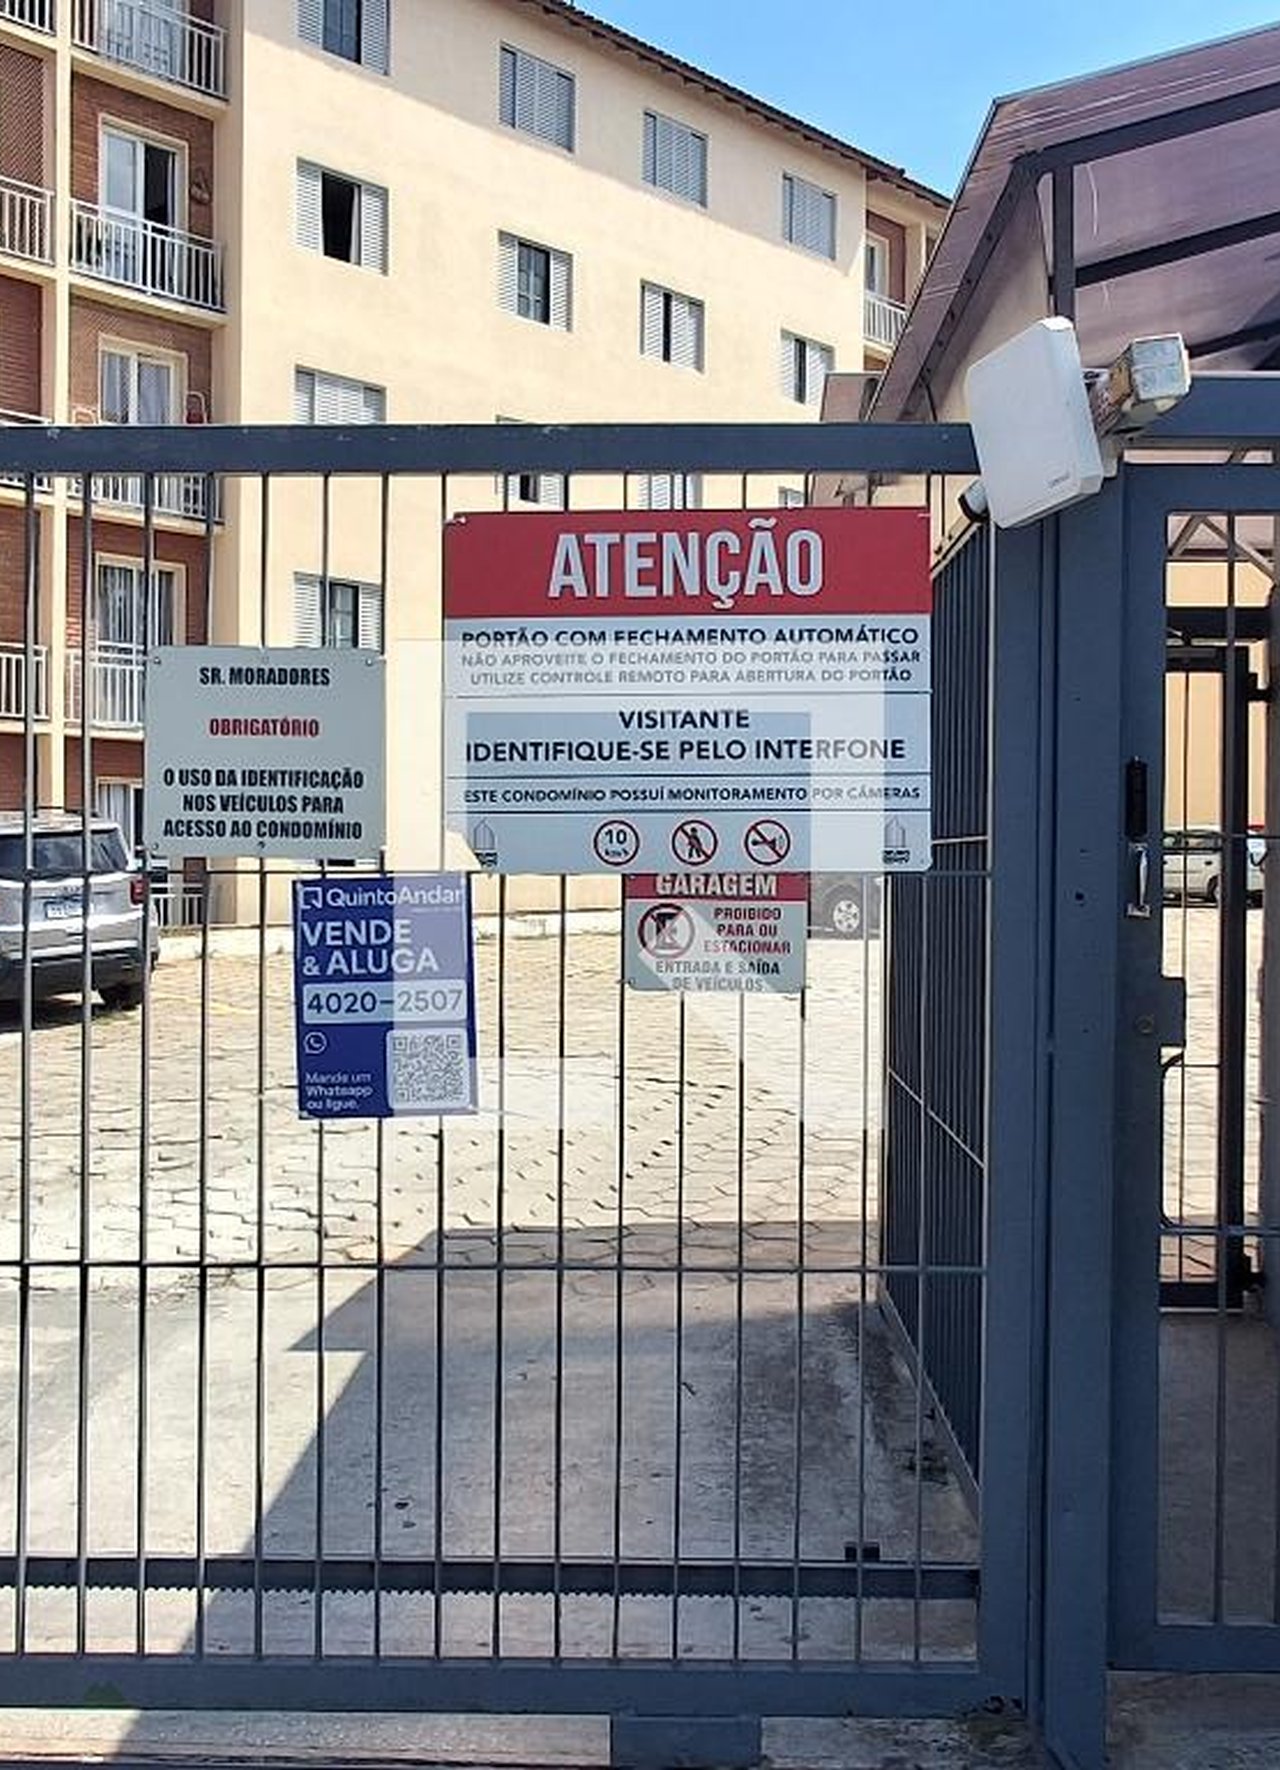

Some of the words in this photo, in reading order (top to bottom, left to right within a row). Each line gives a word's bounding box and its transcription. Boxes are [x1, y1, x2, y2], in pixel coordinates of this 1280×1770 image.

[547, 517, 823, 609] ATENÇÃO
[462, 627, 548, 648] PORTÃO
[555, 630, 606, 646] COM
[614, 628, 766, 646] FECHAMENTO
[774, 624, 918, 644] AUTOMÁTICO
[462, 651, 497, 667] NÃO
[502, 652, 587, 667] APROVEITE
[593, 653, 604, 665] O
[610, 651, 717, 665] FECHAMENTO
[723, 651, 746, 664] DO
[751, 649, 813, 663] PORTÃO
[820, 651, 857, 663] PARA
[863, 650, 920, 663] PASSAR
[199, 667, 226, 685] SR.
[229, 667, 330, 686] MORADORES
[471, 671, 525, 685] UTILIZE
[530, 670, 612, 684] CONTROLE
[619, 670, 684, 683] REMOTO
[690, 670, 730, 683] PARA
[736, 669, 815, 682] ABERTURA
[822, 669, 843, 681] DO
[850, 666, 911, 681] PORTÃO
[209, 716, 319, 737] OBRIGATÓRIO
[619, 709, 749, 729] VISITANTE
[467, 741, 669, 762] IDENTIFIQUE-SE
[680, 739, 746, 760] PELO
[756, 739, 905, 760] INTERFONE
[164, 769, 175, 786] O
[178, 769, 211, 787] USO
[216, 769, 239, 787] DA
[241, 767, 364, 791] IDENTIFICAÇÃO
[183, 794, 215, 812] NOS
[220, 792, 298, 814] VEÍCULOS
[301, 796, 344, 814] PARA
[465, 789, 497, 803] ESTE
[501, 786, 606, 803] CONDOMÍNIO
[610, 786, 664, 801] POSSUÍ
[668, 788, 807, 801] MONITORAMENTO
[812, 787, 843, 800] POR
[847, 784, 920, 799] CÂMERAS
[163, 819, 226, 838] ACESSO
[230, 820, 252, 838] AO
[257, 818, 363, 839] CONDOMÍNIO
[605, 829, 627, 844] 10
[656, 874, 777, 896] GARAGEM
[327, 885, 461, 907] QuintoAndar
[714, 907, 782, 920] PROIBIDO
[301, 919, 412, 947] VENDE
[716, 924, 755, 937] PARA
[759, 924, 778, 937] OU
[704, 940, 791, 955] ESTACIONAR
[303, 955, 320, 976] &
[326, 948, 440, 976] ALUGA
[656, 961, 721, 974] ENTRADA
[725, 961, 734, 974] E
[740, 958, 780, 975] SAÍDA
[672, 977, 693, 990] DE
[695, 975, 763, 991] VEÍCULOS
[307, 989, 463, 1014] 4020-2507
[305, 1072, 349, 1084] Mande
[351, 1074, 371, 1082] um
[305, 1085, 374, 1098] Whatsapp
[307, 1101, 323, 1109] ou
